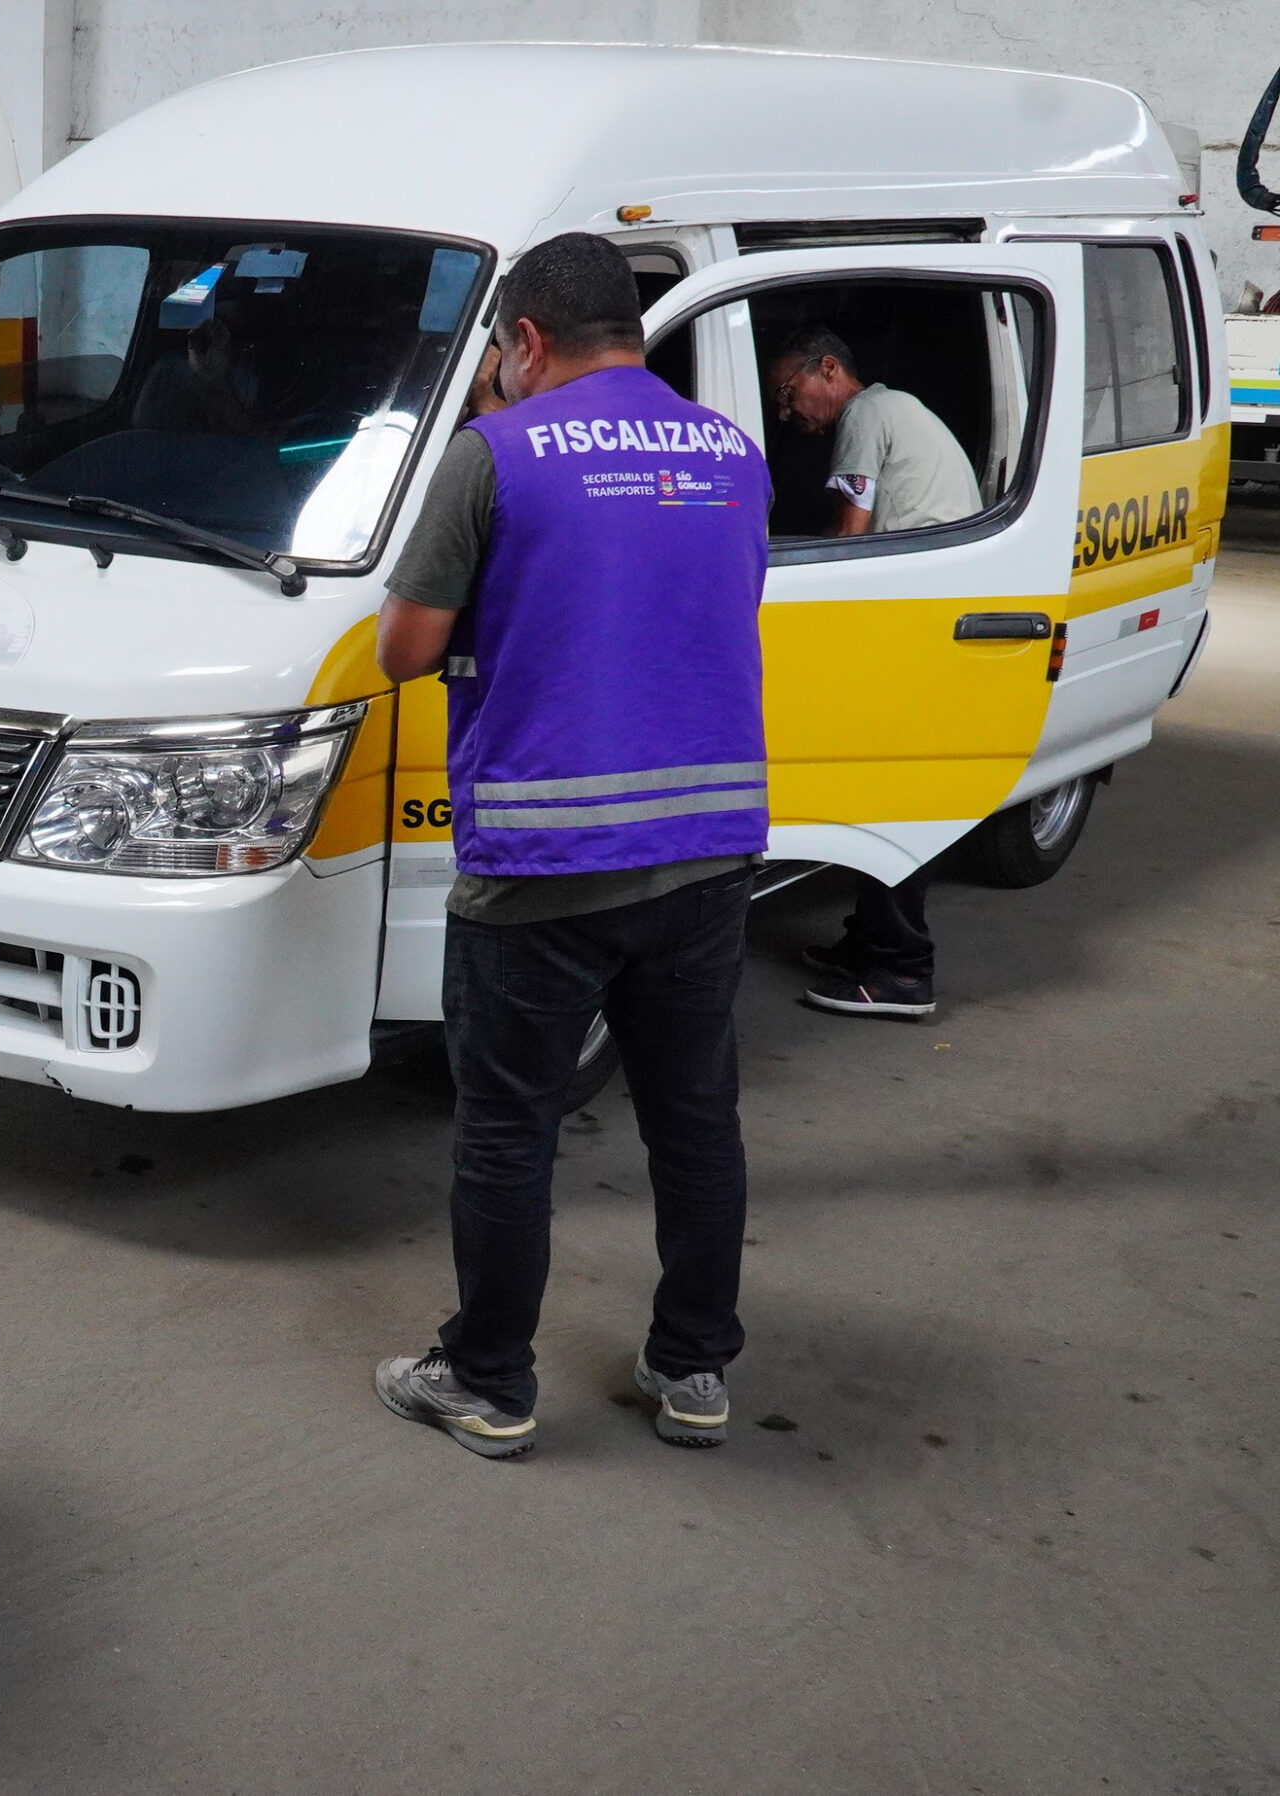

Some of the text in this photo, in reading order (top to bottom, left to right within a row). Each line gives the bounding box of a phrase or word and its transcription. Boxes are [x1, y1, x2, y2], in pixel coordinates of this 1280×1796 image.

[526, 418, 747, 461] FISCALIZAÇÃO
[582, 472, 655, 484] SECRETARIA DE
[676, 470, 692, 481] SÃO
[586, 485, 656, 498] TRANSPORTES
[678, 481, 712, 491] GONÇALO
[402, 798, 452, 828] SG
